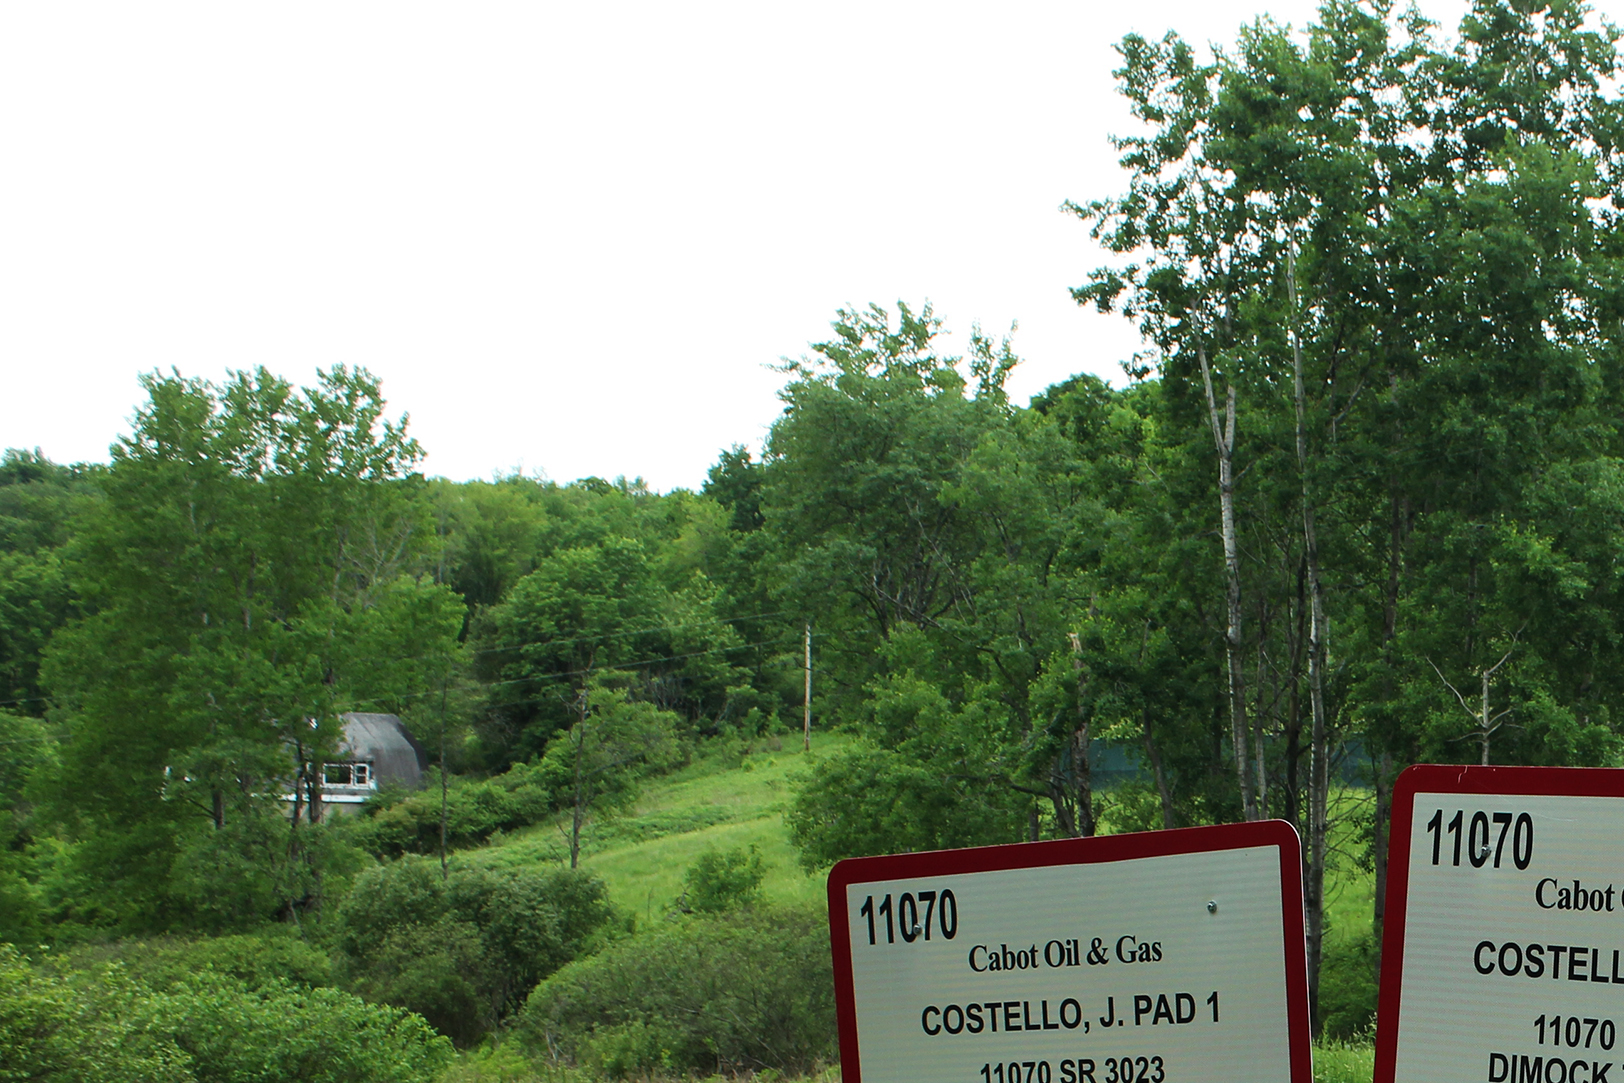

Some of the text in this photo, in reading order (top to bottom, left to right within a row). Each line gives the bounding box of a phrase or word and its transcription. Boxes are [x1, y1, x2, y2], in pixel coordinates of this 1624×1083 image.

[1427, 809, 1534, 871] 11070
[1535, 877, 1616, 913] Cabot
[860, 888, 958, 946] 11070
[968, 935, 1163, 973] Cabot Oil & Gas
[921, 990, 1219, 1036] COSTELLO, J. PAD 1
[1533, 1014, 1616, 1051] 11070
